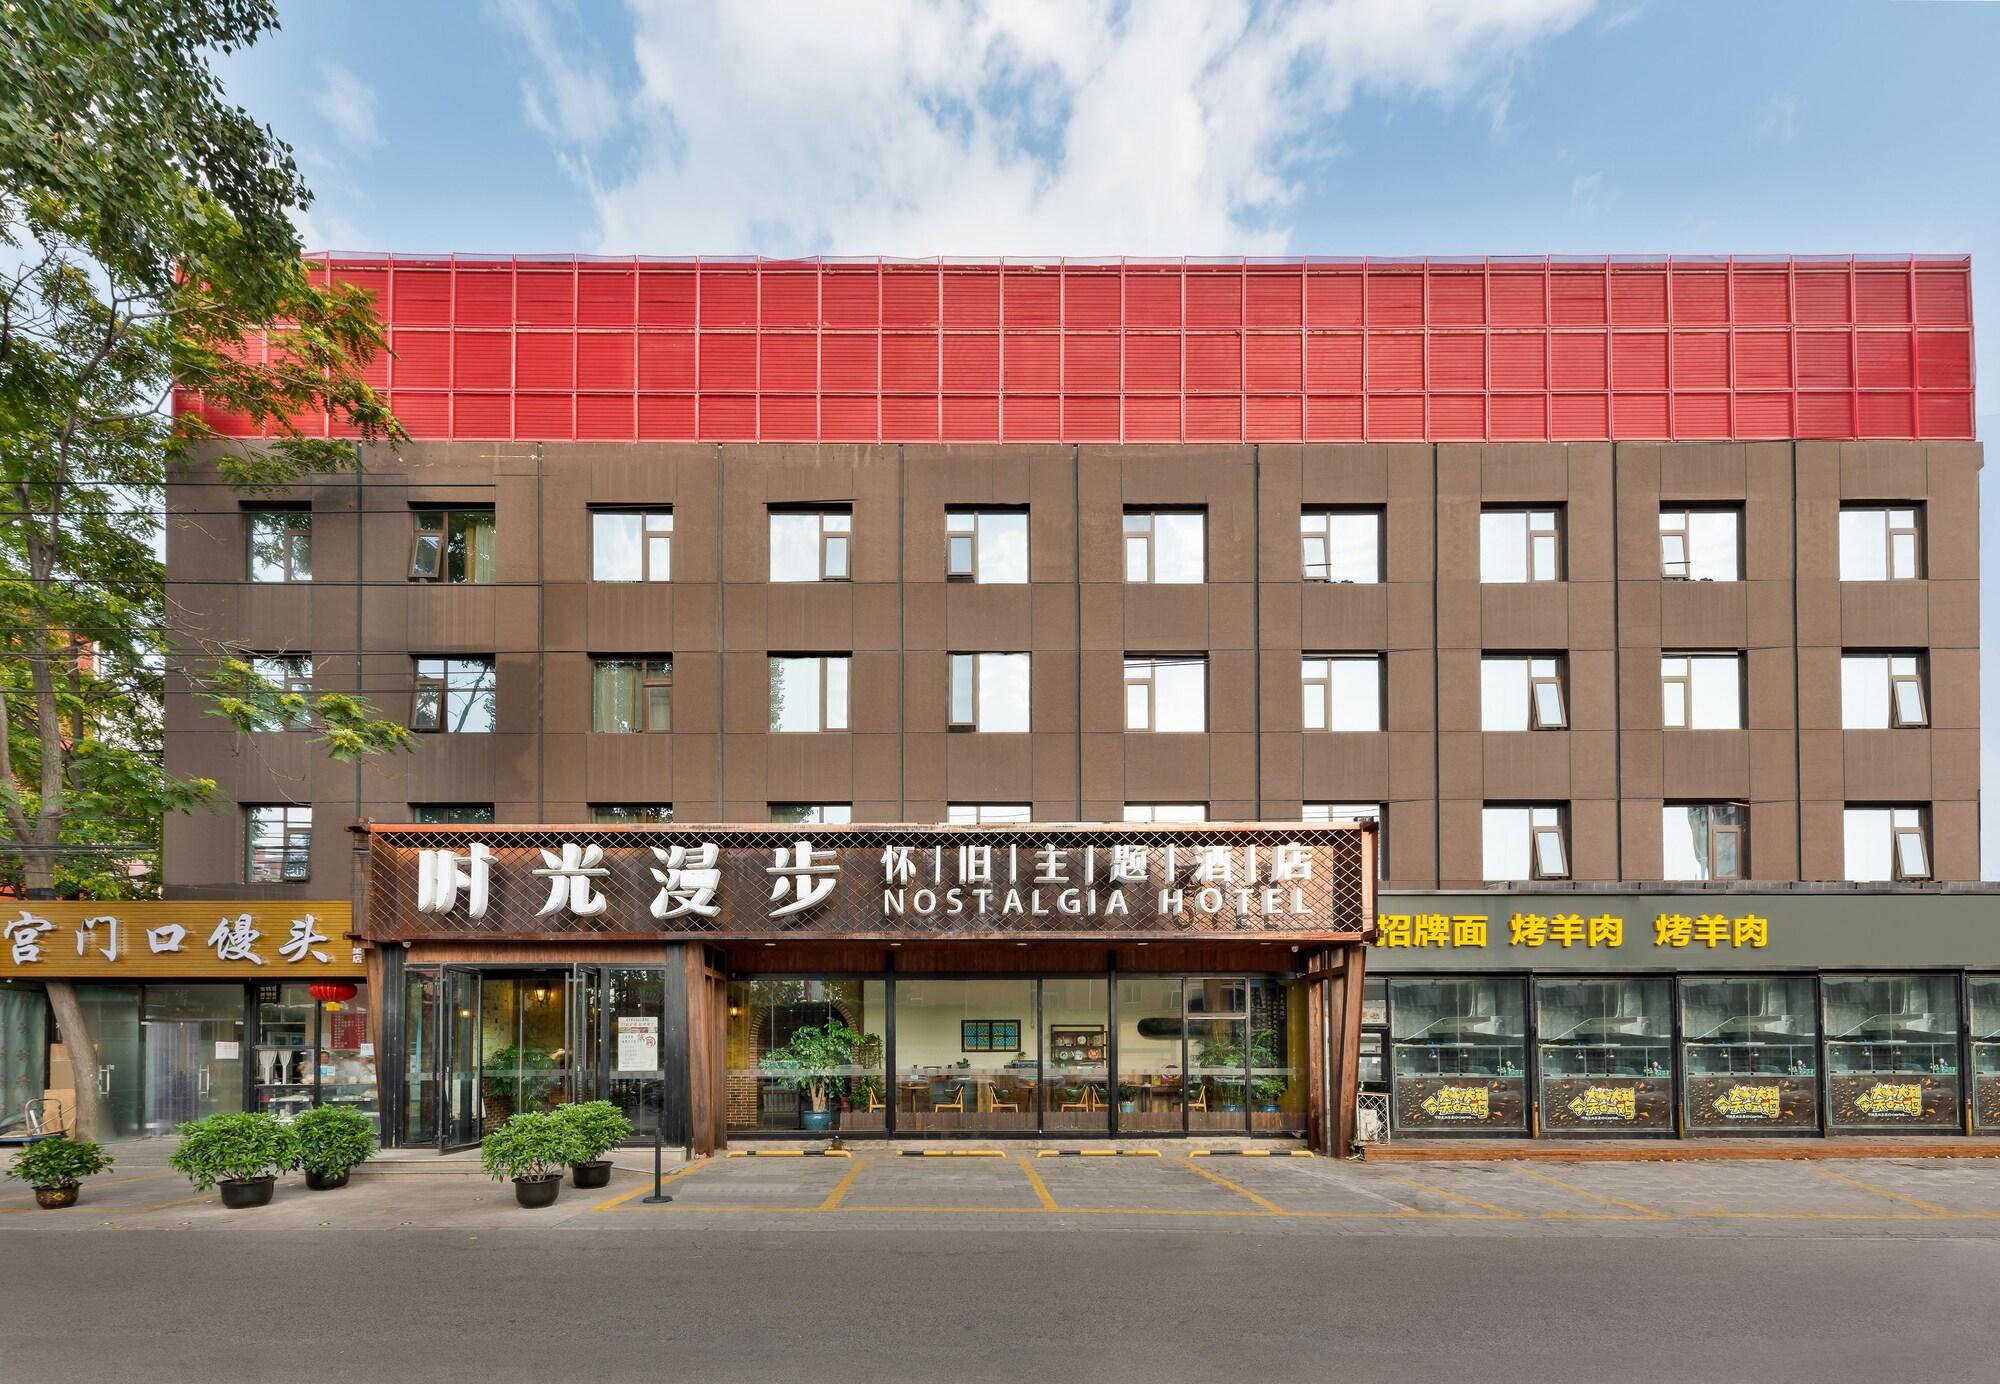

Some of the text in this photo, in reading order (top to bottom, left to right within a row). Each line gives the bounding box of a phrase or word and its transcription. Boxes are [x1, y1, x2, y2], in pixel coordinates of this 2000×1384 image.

[418, 841, 841, 918] 时光漫步
[883, 887, 1313, 916] NOSTALGIA HOTEL
[3, 910, 331, 966] 宫门口馒头
[1374, 913, 1769, 948] 招牌面 烤羊肉 烤羊肉
